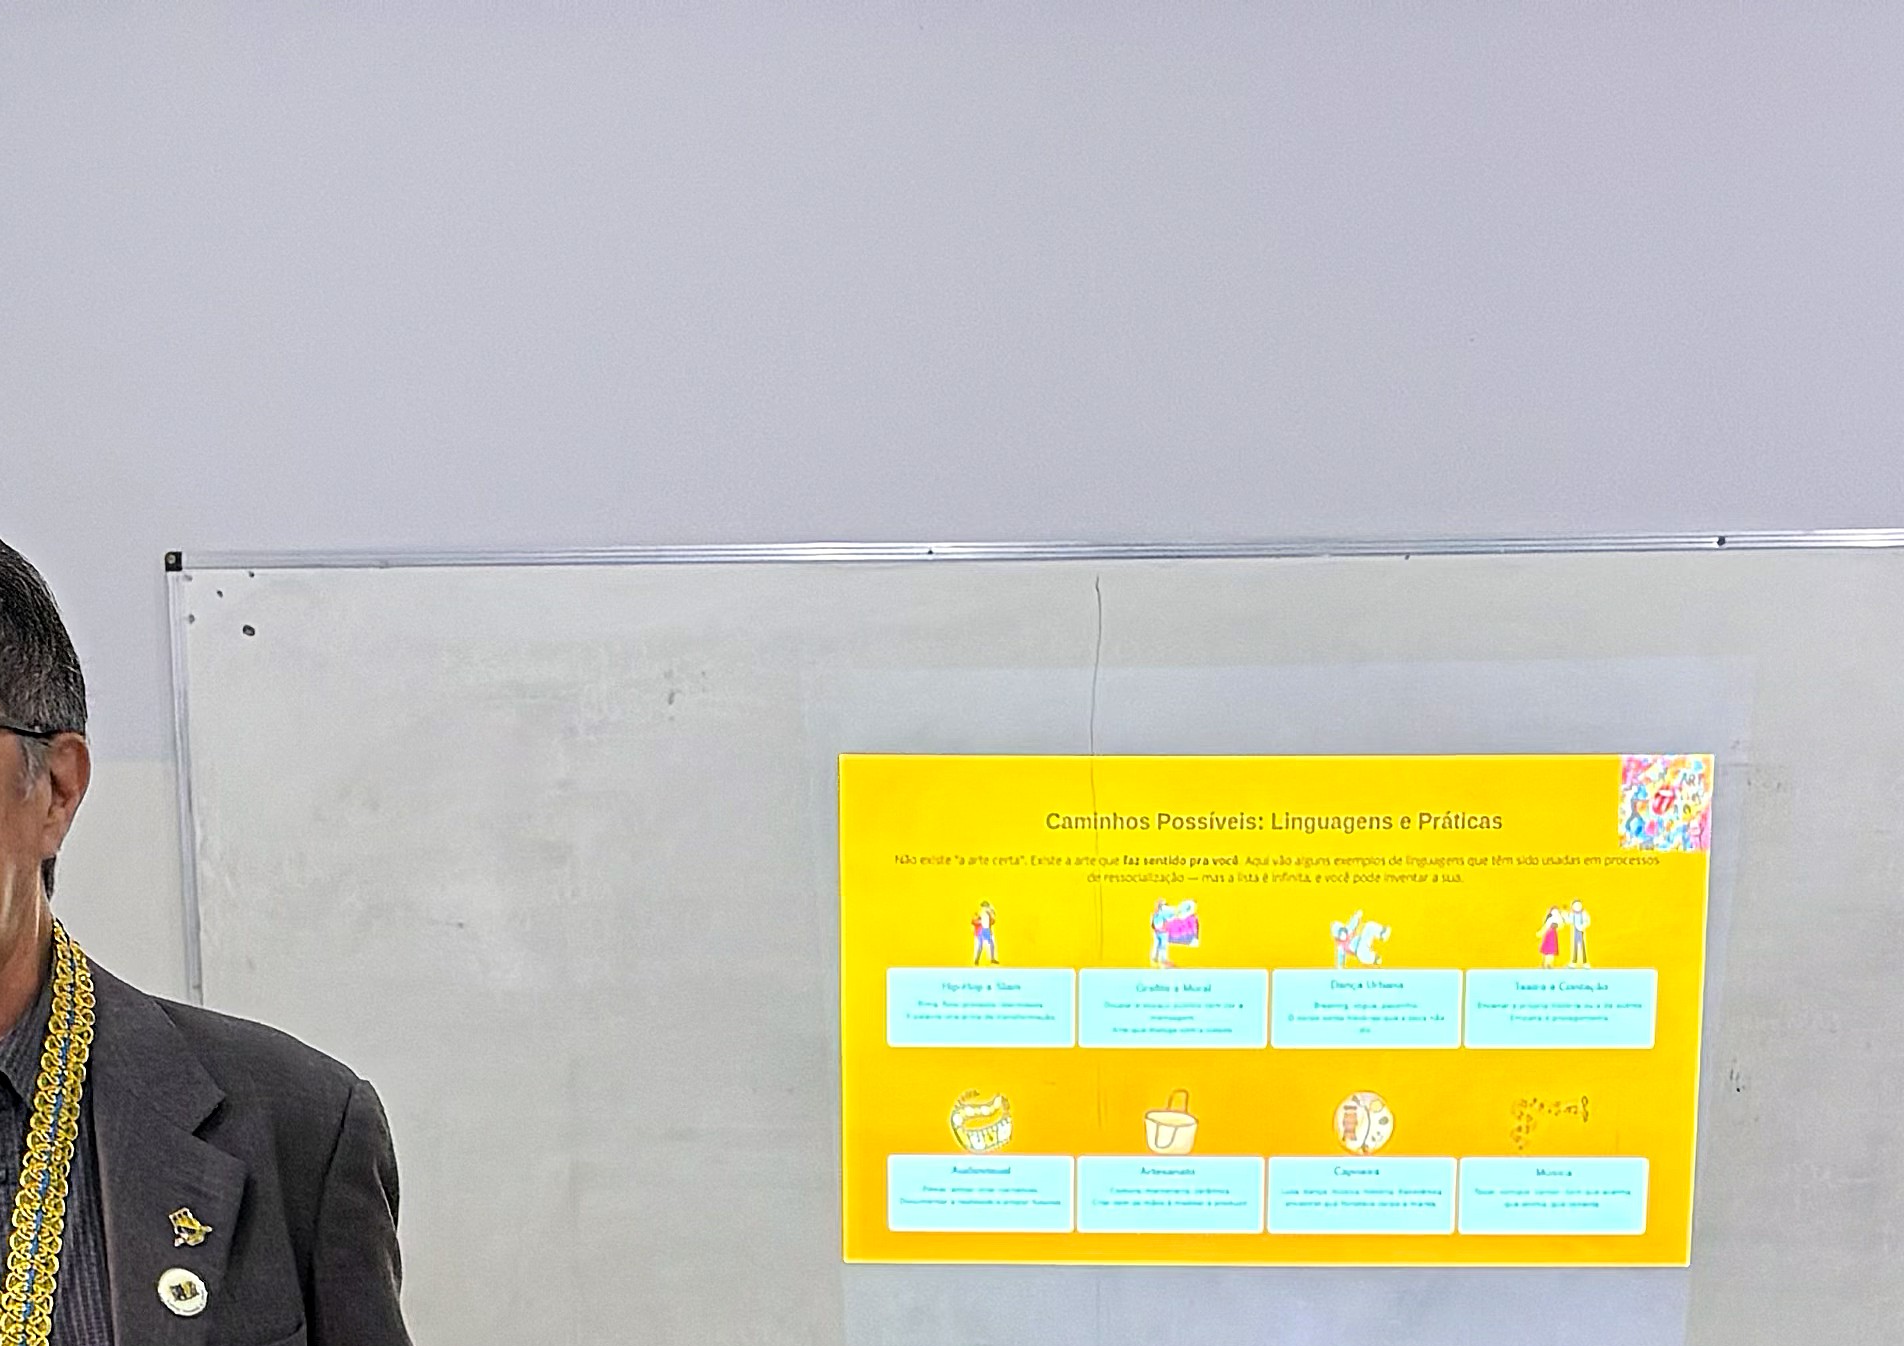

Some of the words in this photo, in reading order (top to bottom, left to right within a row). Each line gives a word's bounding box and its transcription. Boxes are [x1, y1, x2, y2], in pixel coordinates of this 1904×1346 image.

[1046, 812, 1150, 830] Caminhos
[1157, 811, 1264, 830] Possíveis:
[1271, 812, 1393, 834] Linguagens
[1400, 816, 1411, 830] e
[1419, 811, 1503, 830] Práticas
[968, 856, 989, 866] arte
[1074, 857, 1096, 866] arte
[1099, 857, 1119, 868] que
[1123, 855, 1140, 866] faz
[1144, 855, 1186, 866] sentido
[1189, 857, 1209, 868] pra
[1272, 855, 1292, 866] vão
[1295, 856, 1330, 868] alguns
[1334, 856, 1385, 868] exemplos
[1388, 856, 1403, 866] de
[1405, 856, 1465, 868] linguagens
[1467, 857, 1488, 868] que
[1491, 856, 1513, 866] têm
[1516, 856, 1539, 866] sido
[1542, 856, 1580, 866] usadas
[1583, 858, 1601, 866] em
[1604, 857, 1660, 868] processos
[1087, 873, 1101, 883] de
[1104, 872, 1184, 885] ressocialização
[1202, 874, 1224, 883] mas
[1315, 874, 1322, 883] e
[1324, 872, 1350, 883] você
[1353, 873, 1381, 885] pode
[1384, 873, 1428, 883] inventar
